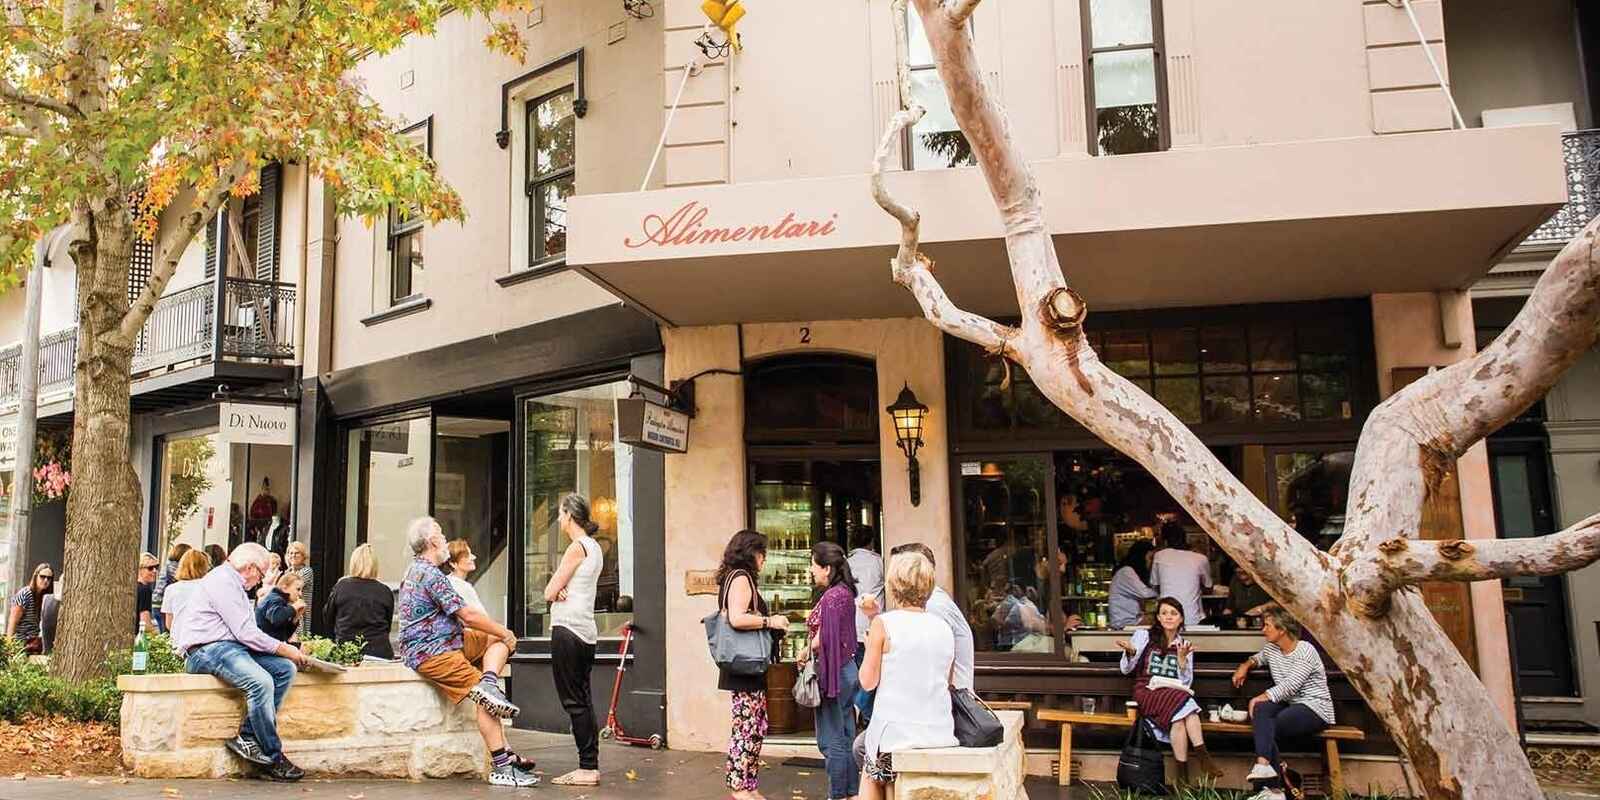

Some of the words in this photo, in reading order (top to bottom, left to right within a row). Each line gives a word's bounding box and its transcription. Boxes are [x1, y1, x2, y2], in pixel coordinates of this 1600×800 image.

[624, 201, 838, 248] Alimentari
[800, 327, 811, 344] 2
[229, 413, 244, 428] Di
[248, 414, 287, 430] Nuovo
[2, 426, 17, 439] ONE
